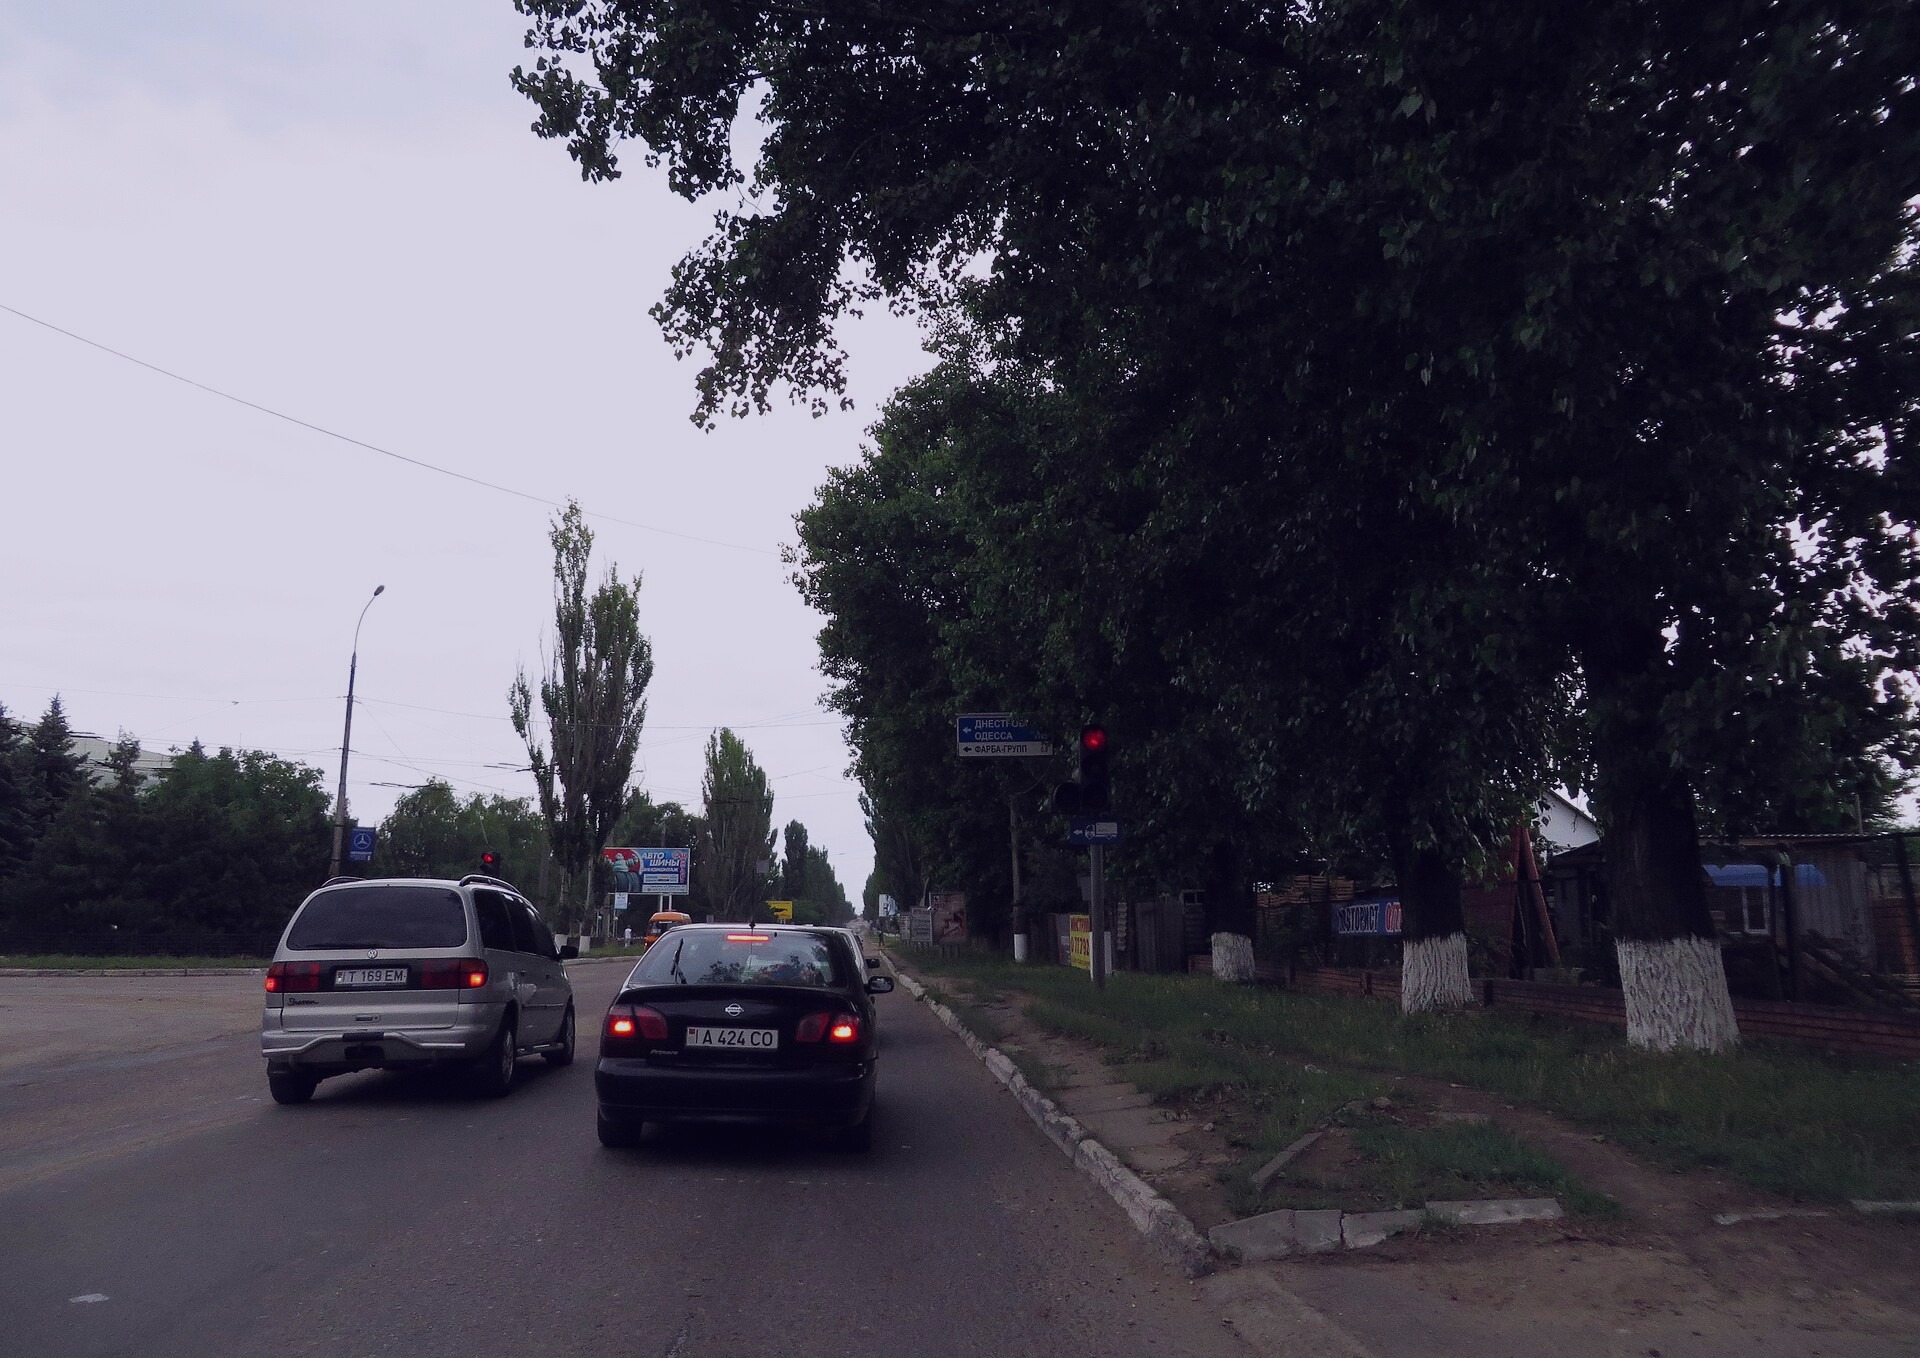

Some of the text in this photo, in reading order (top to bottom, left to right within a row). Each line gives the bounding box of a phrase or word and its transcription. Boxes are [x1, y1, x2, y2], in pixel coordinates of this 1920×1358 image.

[974, 731, 1013, 741] ОДЕССА
[974, 744, 1027, 753] ФАРБА-ГРУПП
[641, 852, 665, 860] АВТО
[649, 859, 680, 867] ШИНЫ
[349, 969, 403, 982] T 169 EM
[702, 1029, 773, 1047] A 424 CO
